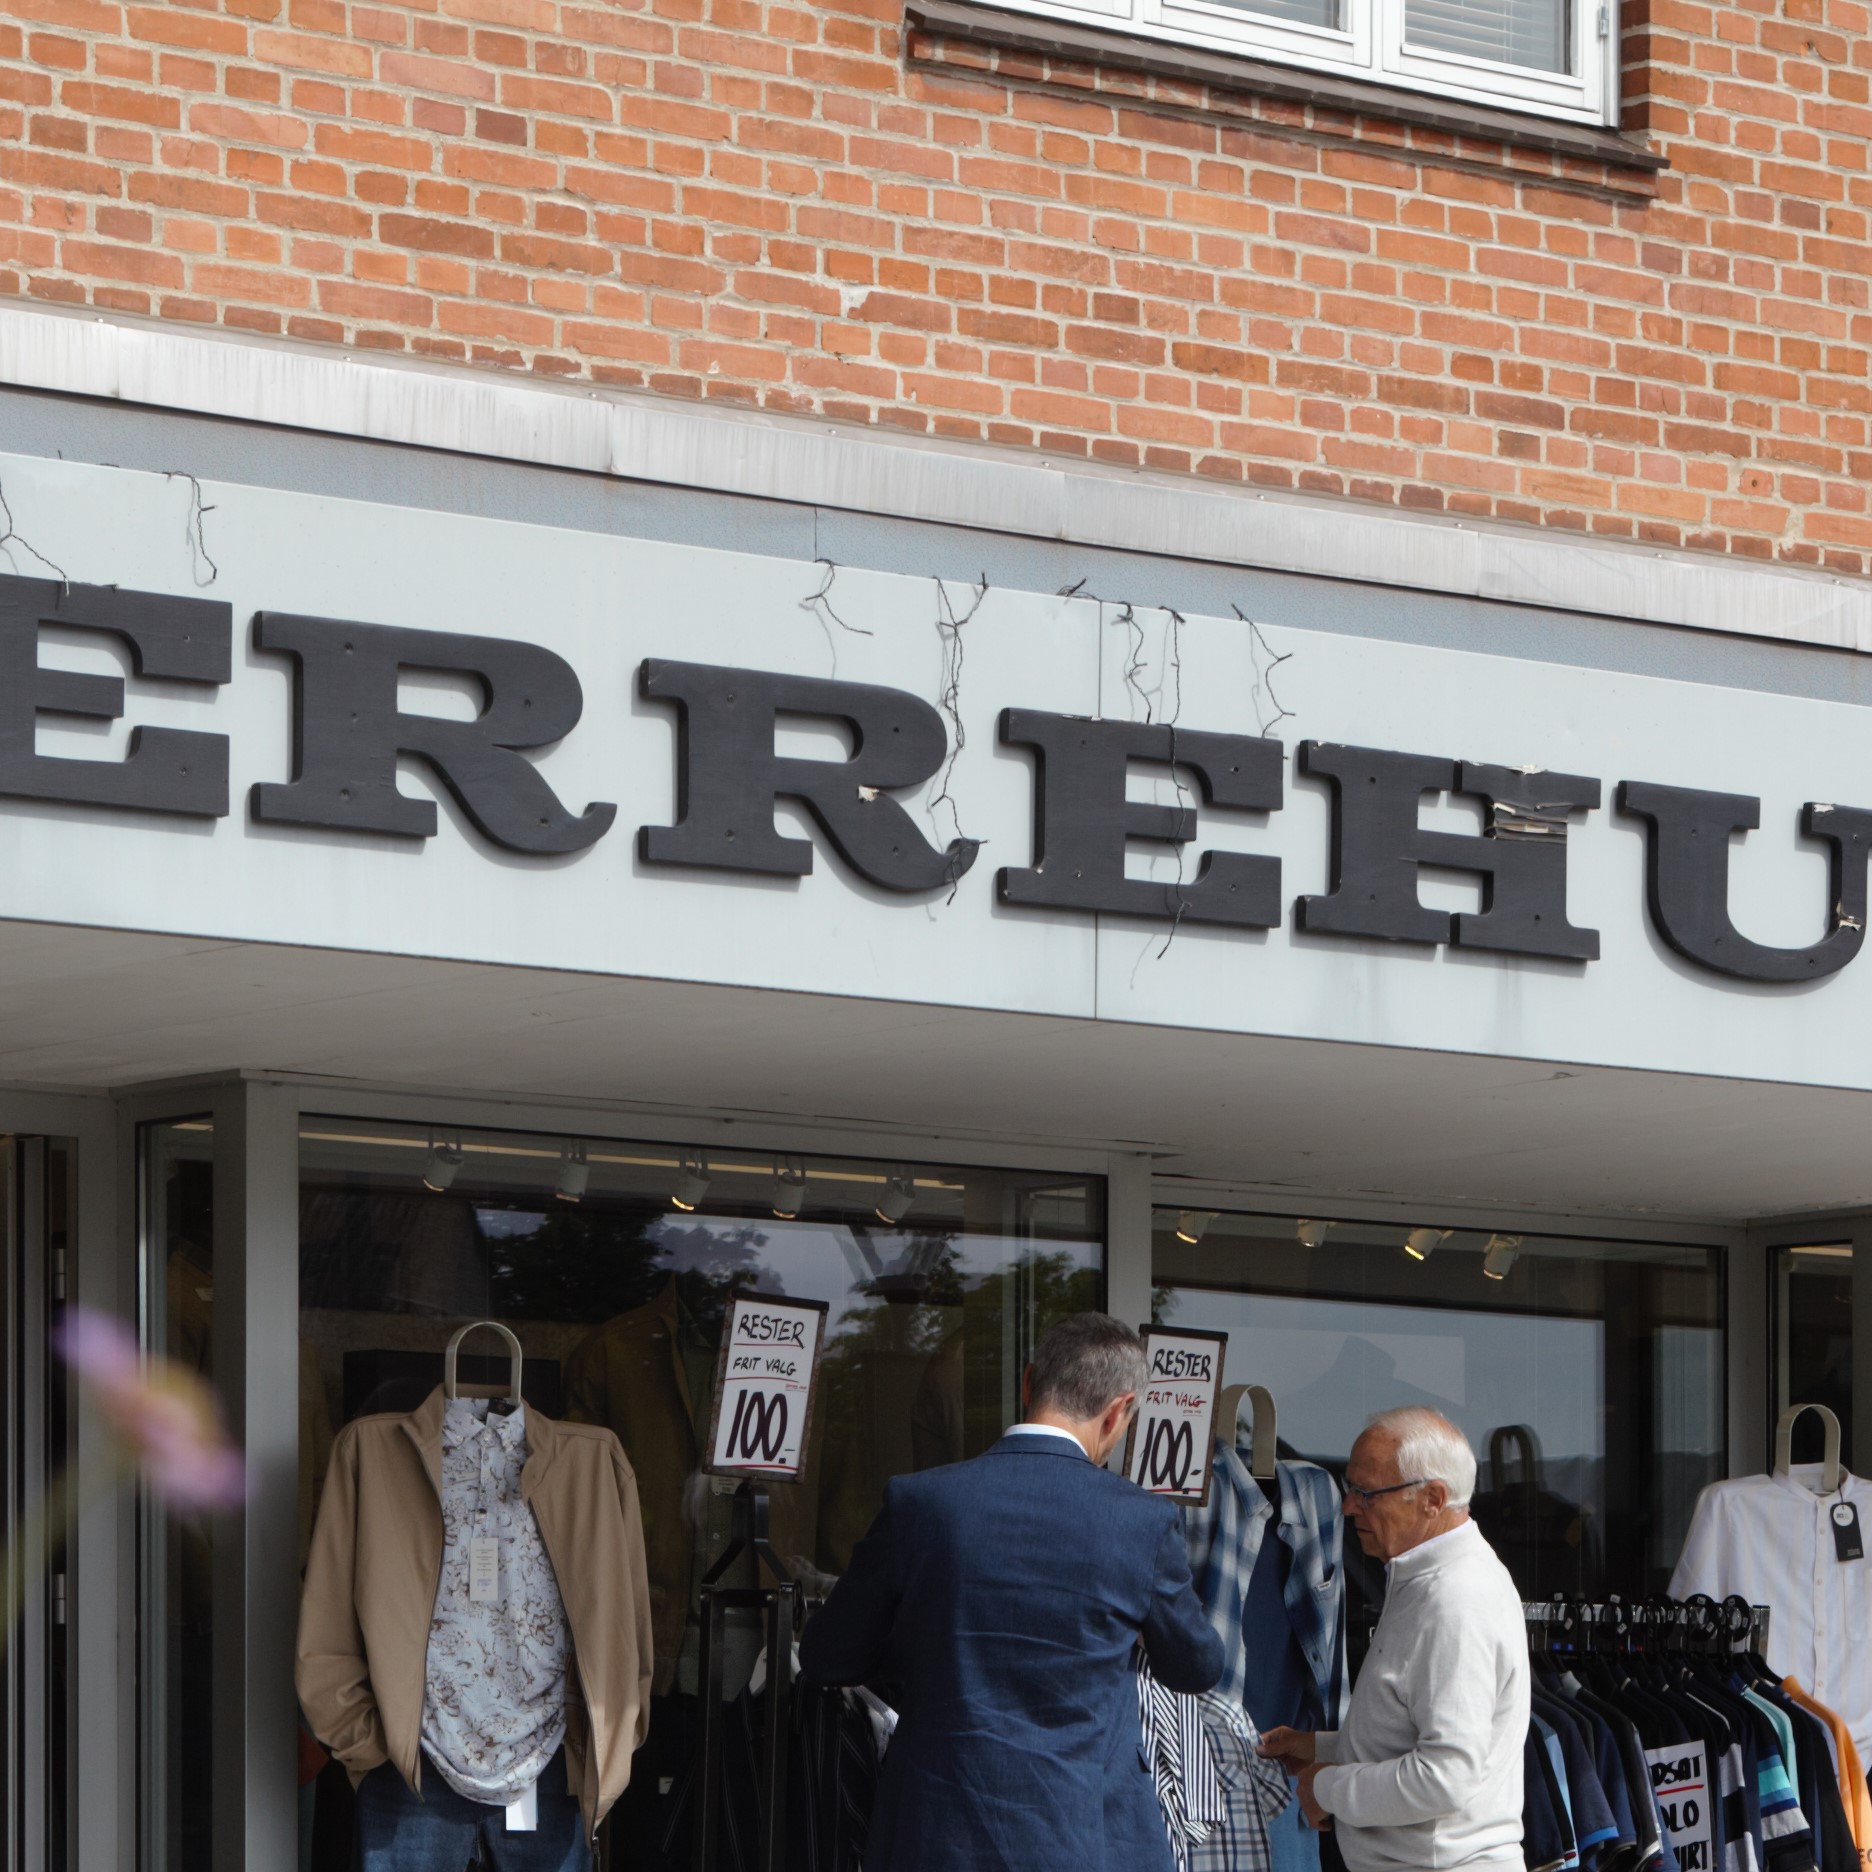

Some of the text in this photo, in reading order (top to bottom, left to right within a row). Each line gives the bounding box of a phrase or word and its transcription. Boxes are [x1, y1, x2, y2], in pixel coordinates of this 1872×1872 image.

[737, 1314, 805, 1350] RESTER
[732, 1356, 797, 1377] FRIT VALG
[1151, 1348, 1211, 1383] RESTER
[1146, 1390, 1207, 1409] FRIT VALG
